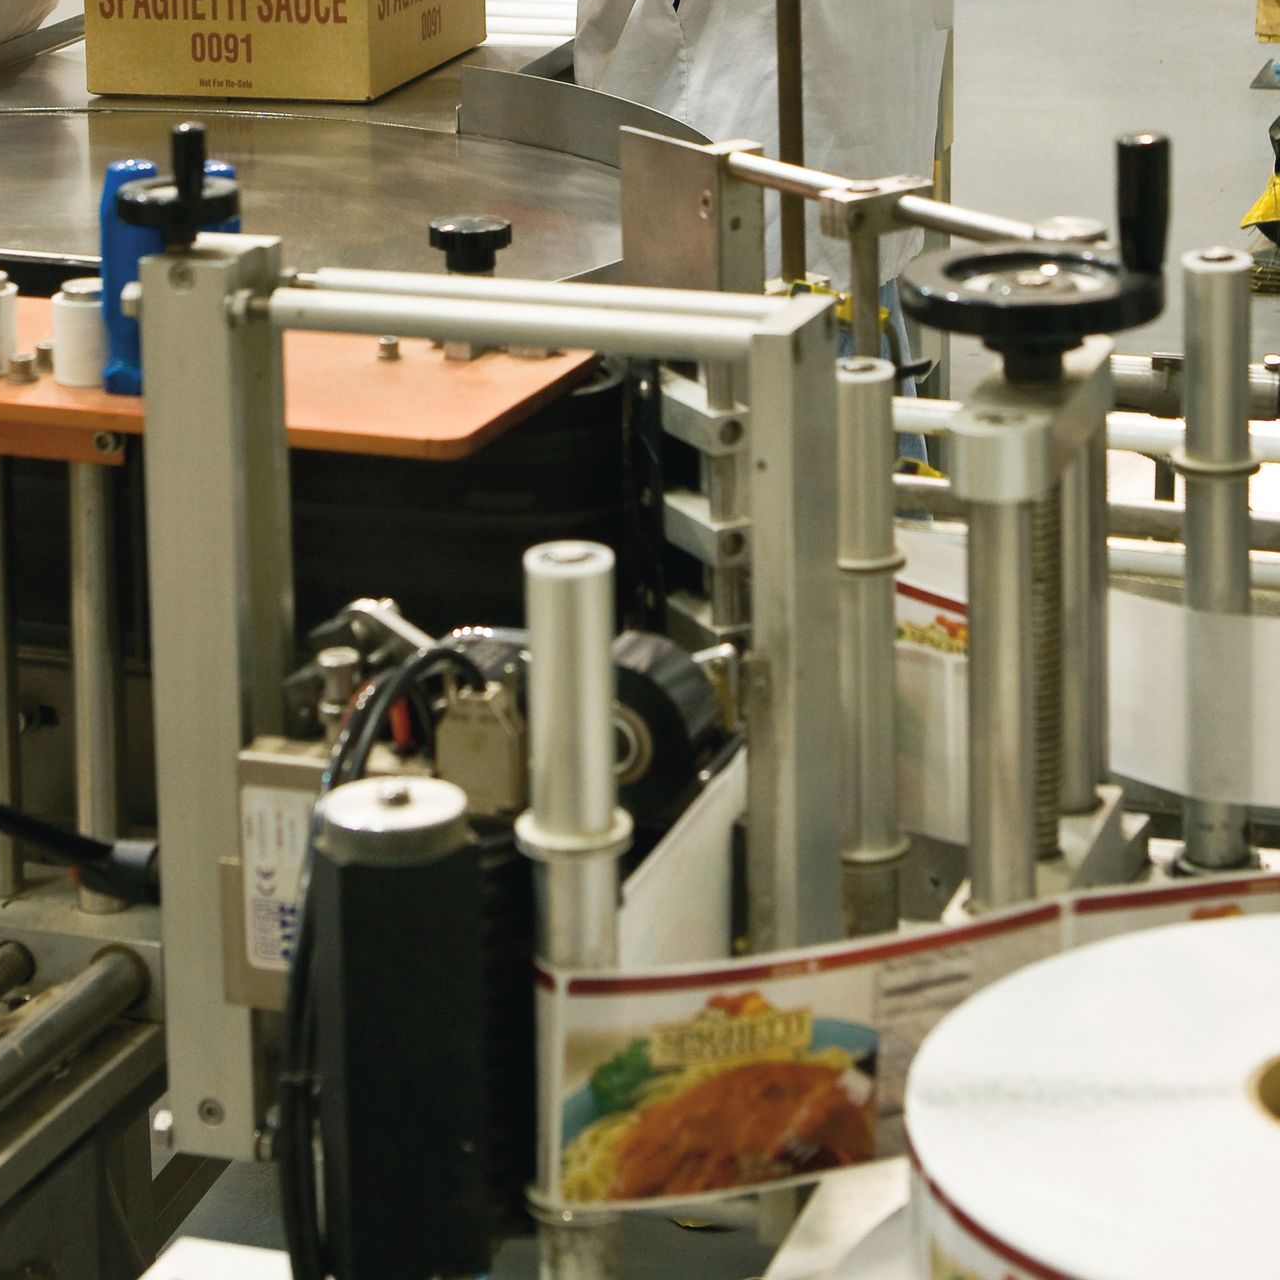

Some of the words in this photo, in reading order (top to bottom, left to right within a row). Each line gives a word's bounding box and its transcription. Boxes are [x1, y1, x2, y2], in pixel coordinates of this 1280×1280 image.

[421, 8, 442, 41] 0091
[191, 32, 253, 64] 0091
[199, 79, 211, 88] Not
[212, 79, 224, 88] For
